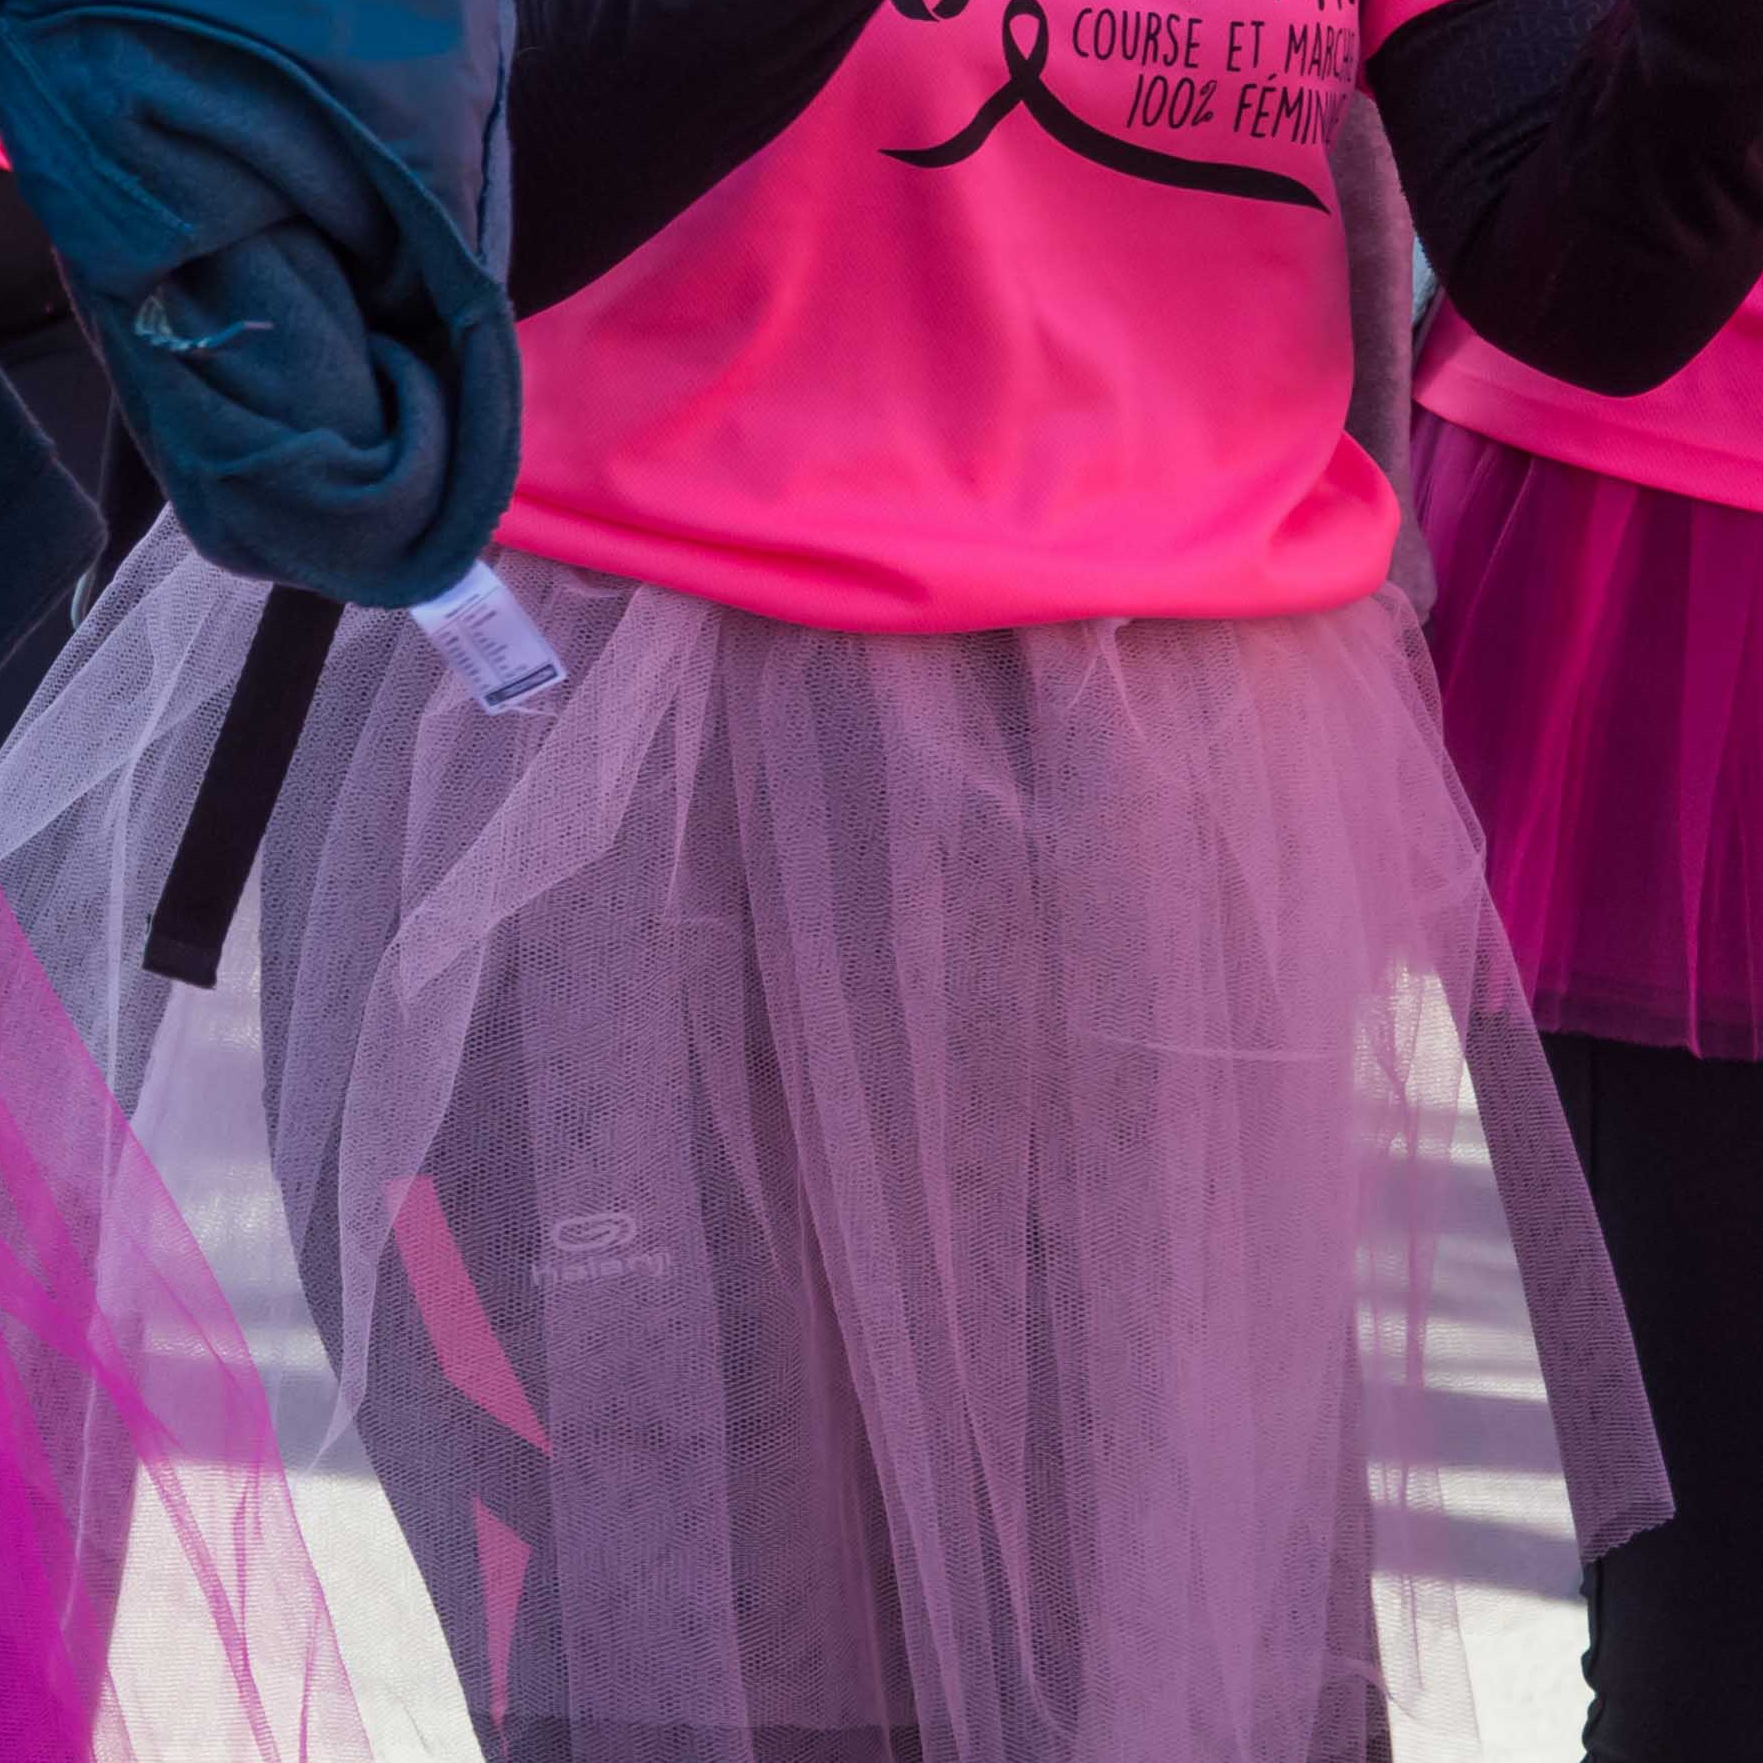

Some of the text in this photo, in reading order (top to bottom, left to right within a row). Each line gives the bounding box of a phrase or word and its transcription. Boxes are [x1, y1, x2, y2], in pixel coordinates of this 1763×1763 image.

[1073, 7, 1203, 70] COURSE
[1227, 20, 1266, 73] ET
[1126, 74, 1218, 129] 100%
